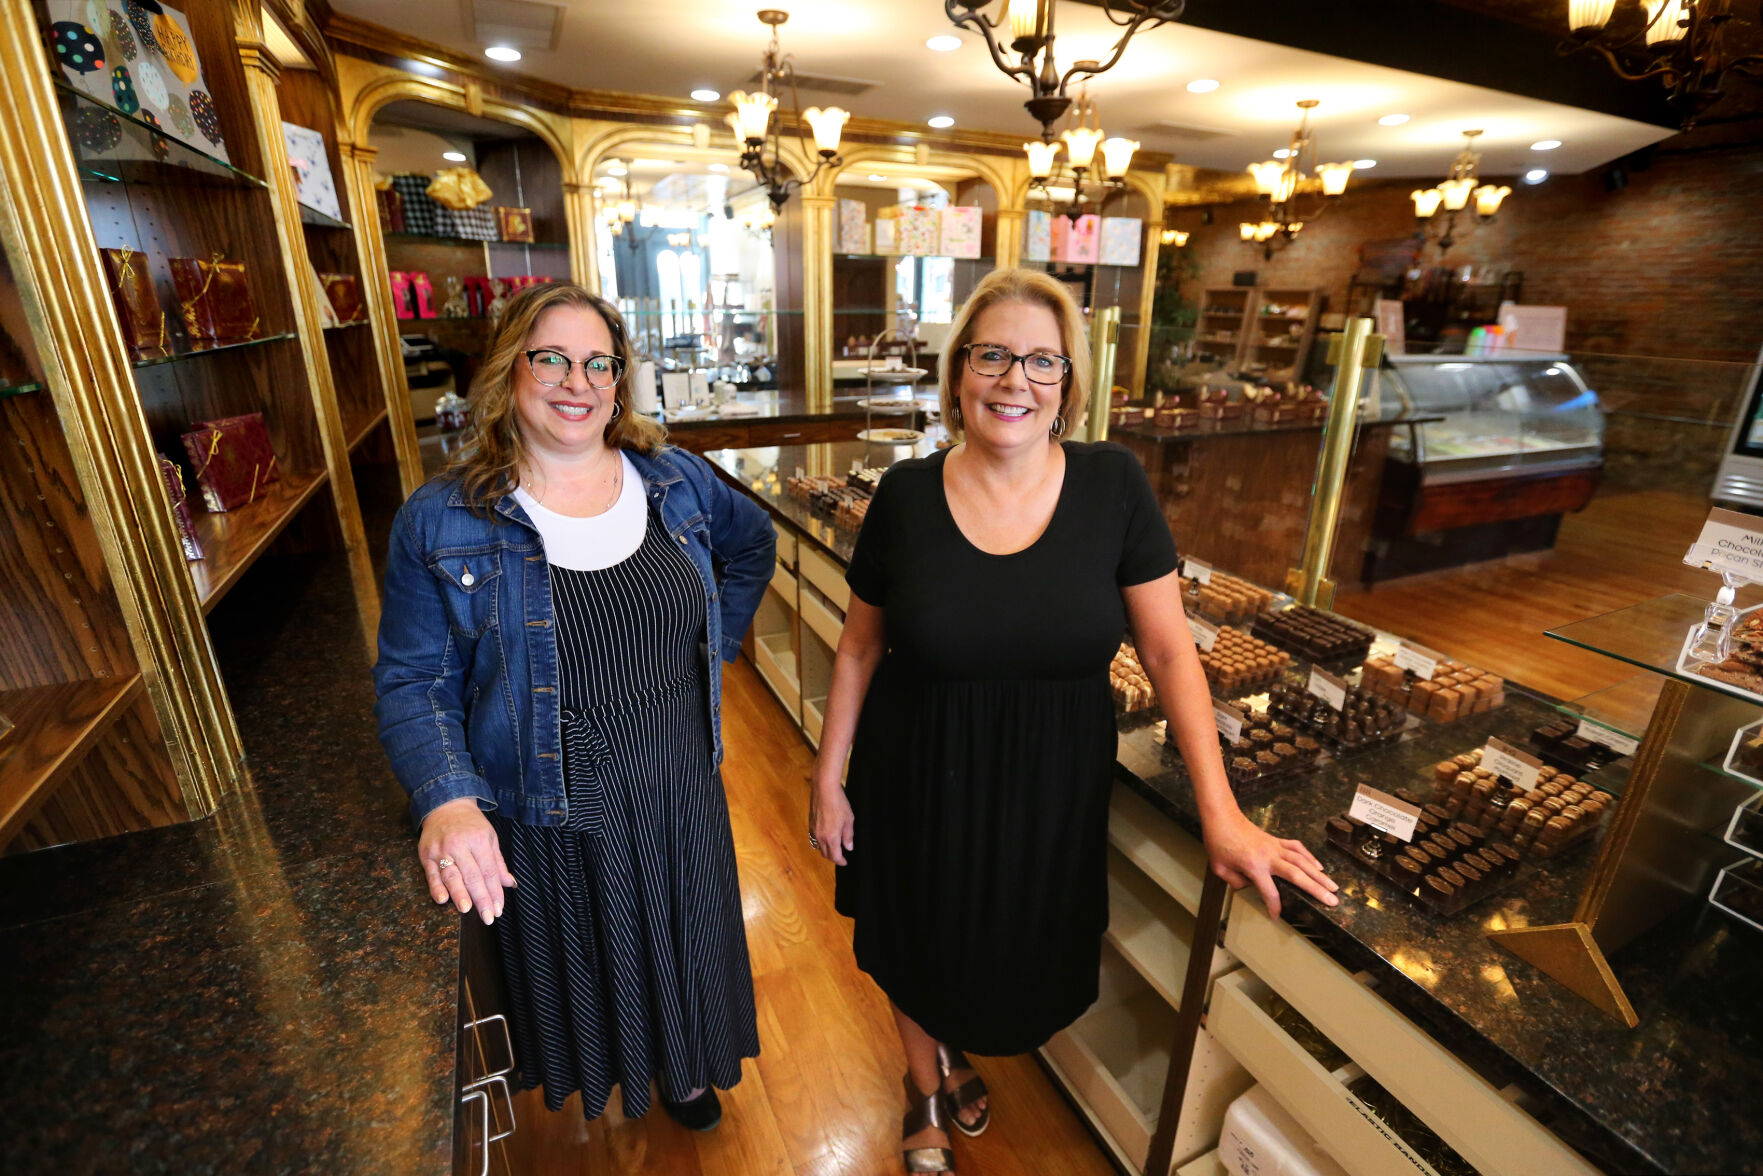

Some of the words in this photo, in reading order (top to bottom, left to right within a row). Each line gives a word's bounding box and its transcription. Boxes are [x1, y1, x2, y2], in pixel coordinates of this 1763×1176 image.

[155, 24, 188, 50] HAPPY
[1718, 539, 1763, 558] Chocol
[1357, 795, 1374, 806] Dark
[1374, 803, 1413, 824] Chocolate
[1369, 808, 1396, 824] Orange
[1347, 1099, 1392, 1141] ELASTIC
